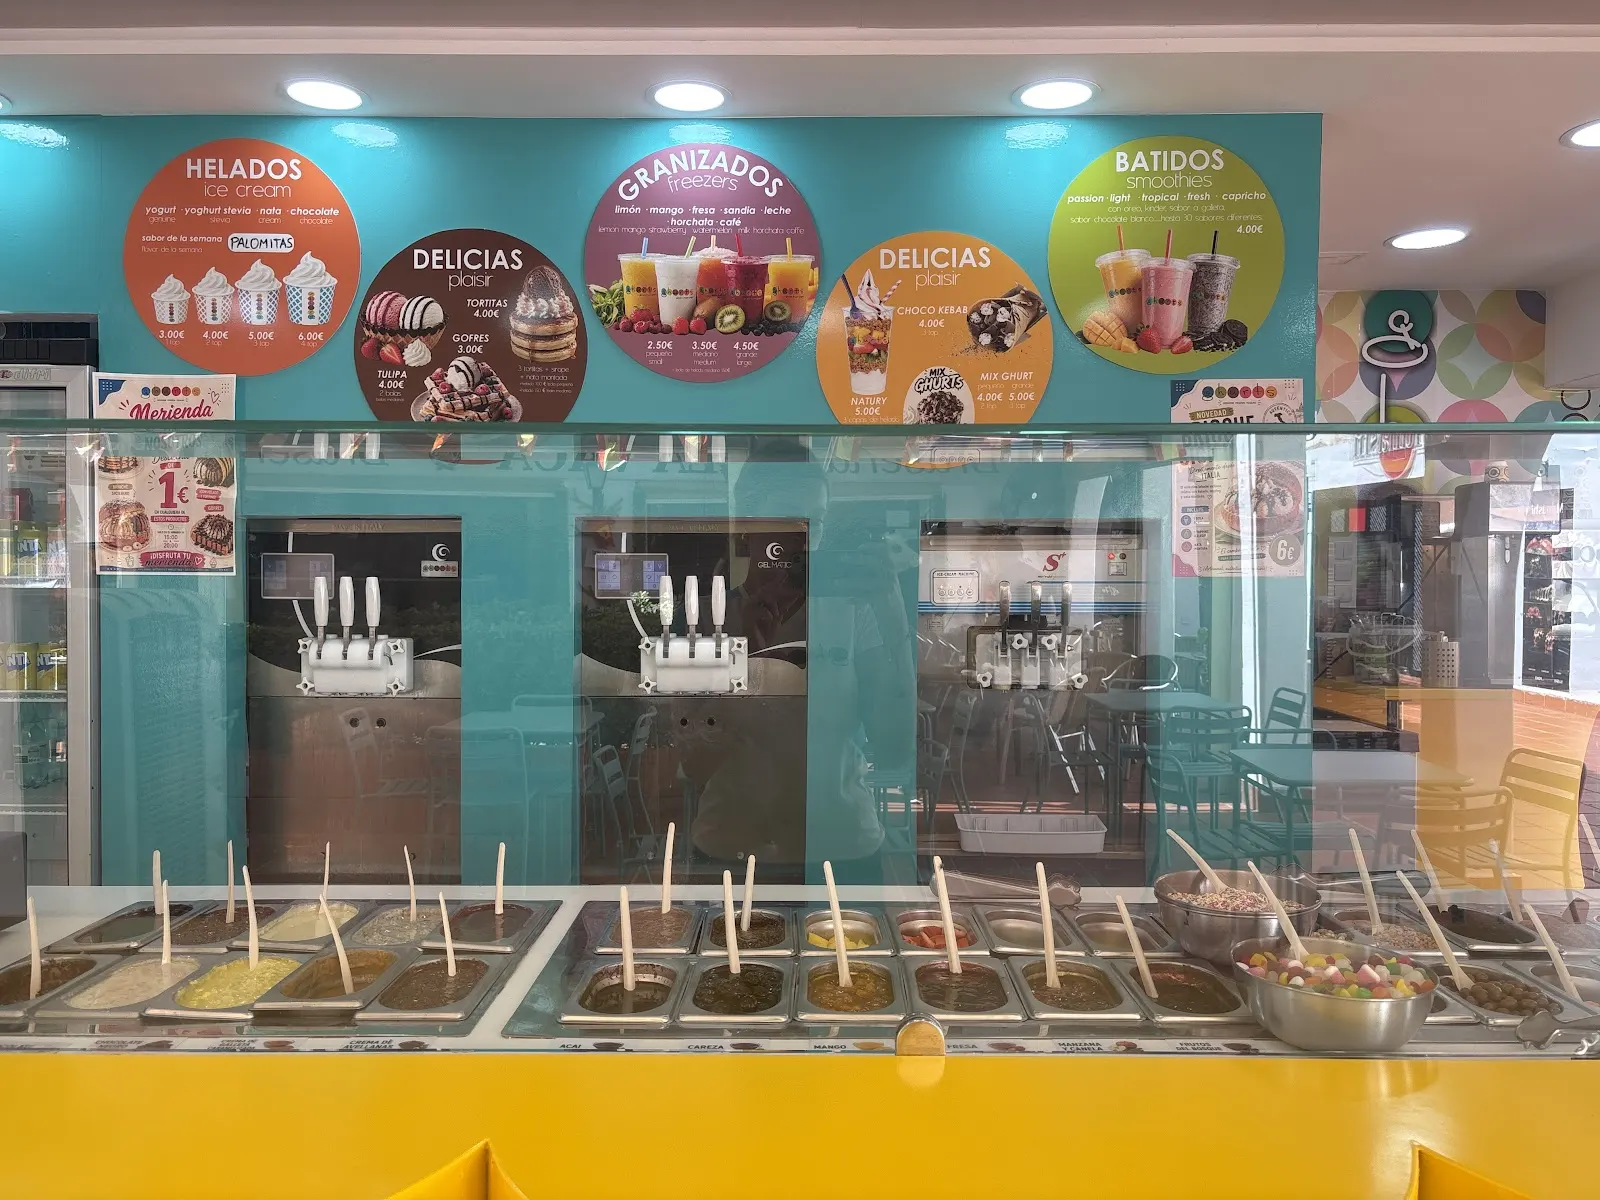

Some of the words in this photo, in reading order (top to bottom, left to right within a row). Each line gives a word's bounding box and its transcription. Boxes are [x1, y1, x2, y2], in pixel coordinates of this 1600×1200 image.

[1115, 149, 1224, 172] BATIDOS
[186, 158, 301, 180] HELADOS
[618, 149, 784, 201] GRANIZADOS
[668, 174, 739, 193] freezers
[1126, 172, 1212, 189] smoothies
[203, 181, 228, 198] ice
[236, 183, 292, 198] cream
[1067, 193, 1104, 204] passion
[1110, 193, 1131, 204] light
[1141, 192, 1180, 203] tropical
[1187, 191, 1211, 201] fresh
[1221, 191, 1266, 202] capricho
[145, 205, 177, 216] yogurt
[184, 205, 222, 216] yoghurt
[223, 205, 252, 215] stevia
[260, 206, 282, 215] nata
[290, 206, 340, 216] chocolate
[614, 204, 641, 214] limón
[649, 206, 684, 216] mango
[691, 205, 716, 215] fresa
[764, 206, 792, 215] leche
[209, 216, 231, 224] stevia
[299, 216, 333, 225] chocolate
[670, 217, 714, 226] horchata
[720, 217, 742, 226] café
[1093, 215, 1128, 223] chocolate
[621, 226, 647, 236] mango
[648, 225, 687, 236] strawberry
[1236, 224, 1264, 234] 4.00€
[141, 234, 165, 242] sabor
[167, 234, 178, 242] de
[180, 234, 188, 242] la
[190, 235, 222, 243] semana
[230, 236, 293, 250] PALOMITAS
[413, 248, 523, 270] DELICIAS
[879, 246, 991, 269] DELICIAS
[448, 270, 494, 291] plaisir
[915, 270, 961, 290] plaisir
[466, 299, 508, 309] TORTITAS
[473, 309, 500, 318] 4.00€
[897, 306, 936, 315] CHOCO
[938, 305, 968, 314] KEBAB
[918, 319, 945, 328] 4.00€
[159, 330, 185, 339] 3.00€
[202, 330, 229, 340] 4.00€
[248, 331, 274, 340] 5.00€
[298, 332, 324, 341] 6.00€
[452, 333, 490, 343] GOFRES
[457, 344, 483, 354] 3.00€
[647, 340, 673, 350] 2.50€
[691, 341, 718, 350] 3.50€
[733, 342, 759, 350] 4.50€
[377, 369, 408, 379] TULIPA
[929, 367, 946, 377] MIX
[980, 372, 999, 381] MIX
[1001, 371, 1034, 381] GHURT
[378, 380, 405, 389] 4.00€
[914, 373, 964, 394] GHURTS
[851, 397, 888, 406] NATURY
[977, 392, 1003, 401] 4.00€
[1008, 392, 1035, 401] 5.00€
[129, 399, 214, 420] Merienda
[855, 407, 881, 416] 5.00€
[1196, 409, 1227, 420] NOVEDAD
[159, 472, 189, 508] 1€
[1276, 539, 1295, 560] 6€
[182, 552, 191, 560] TU
